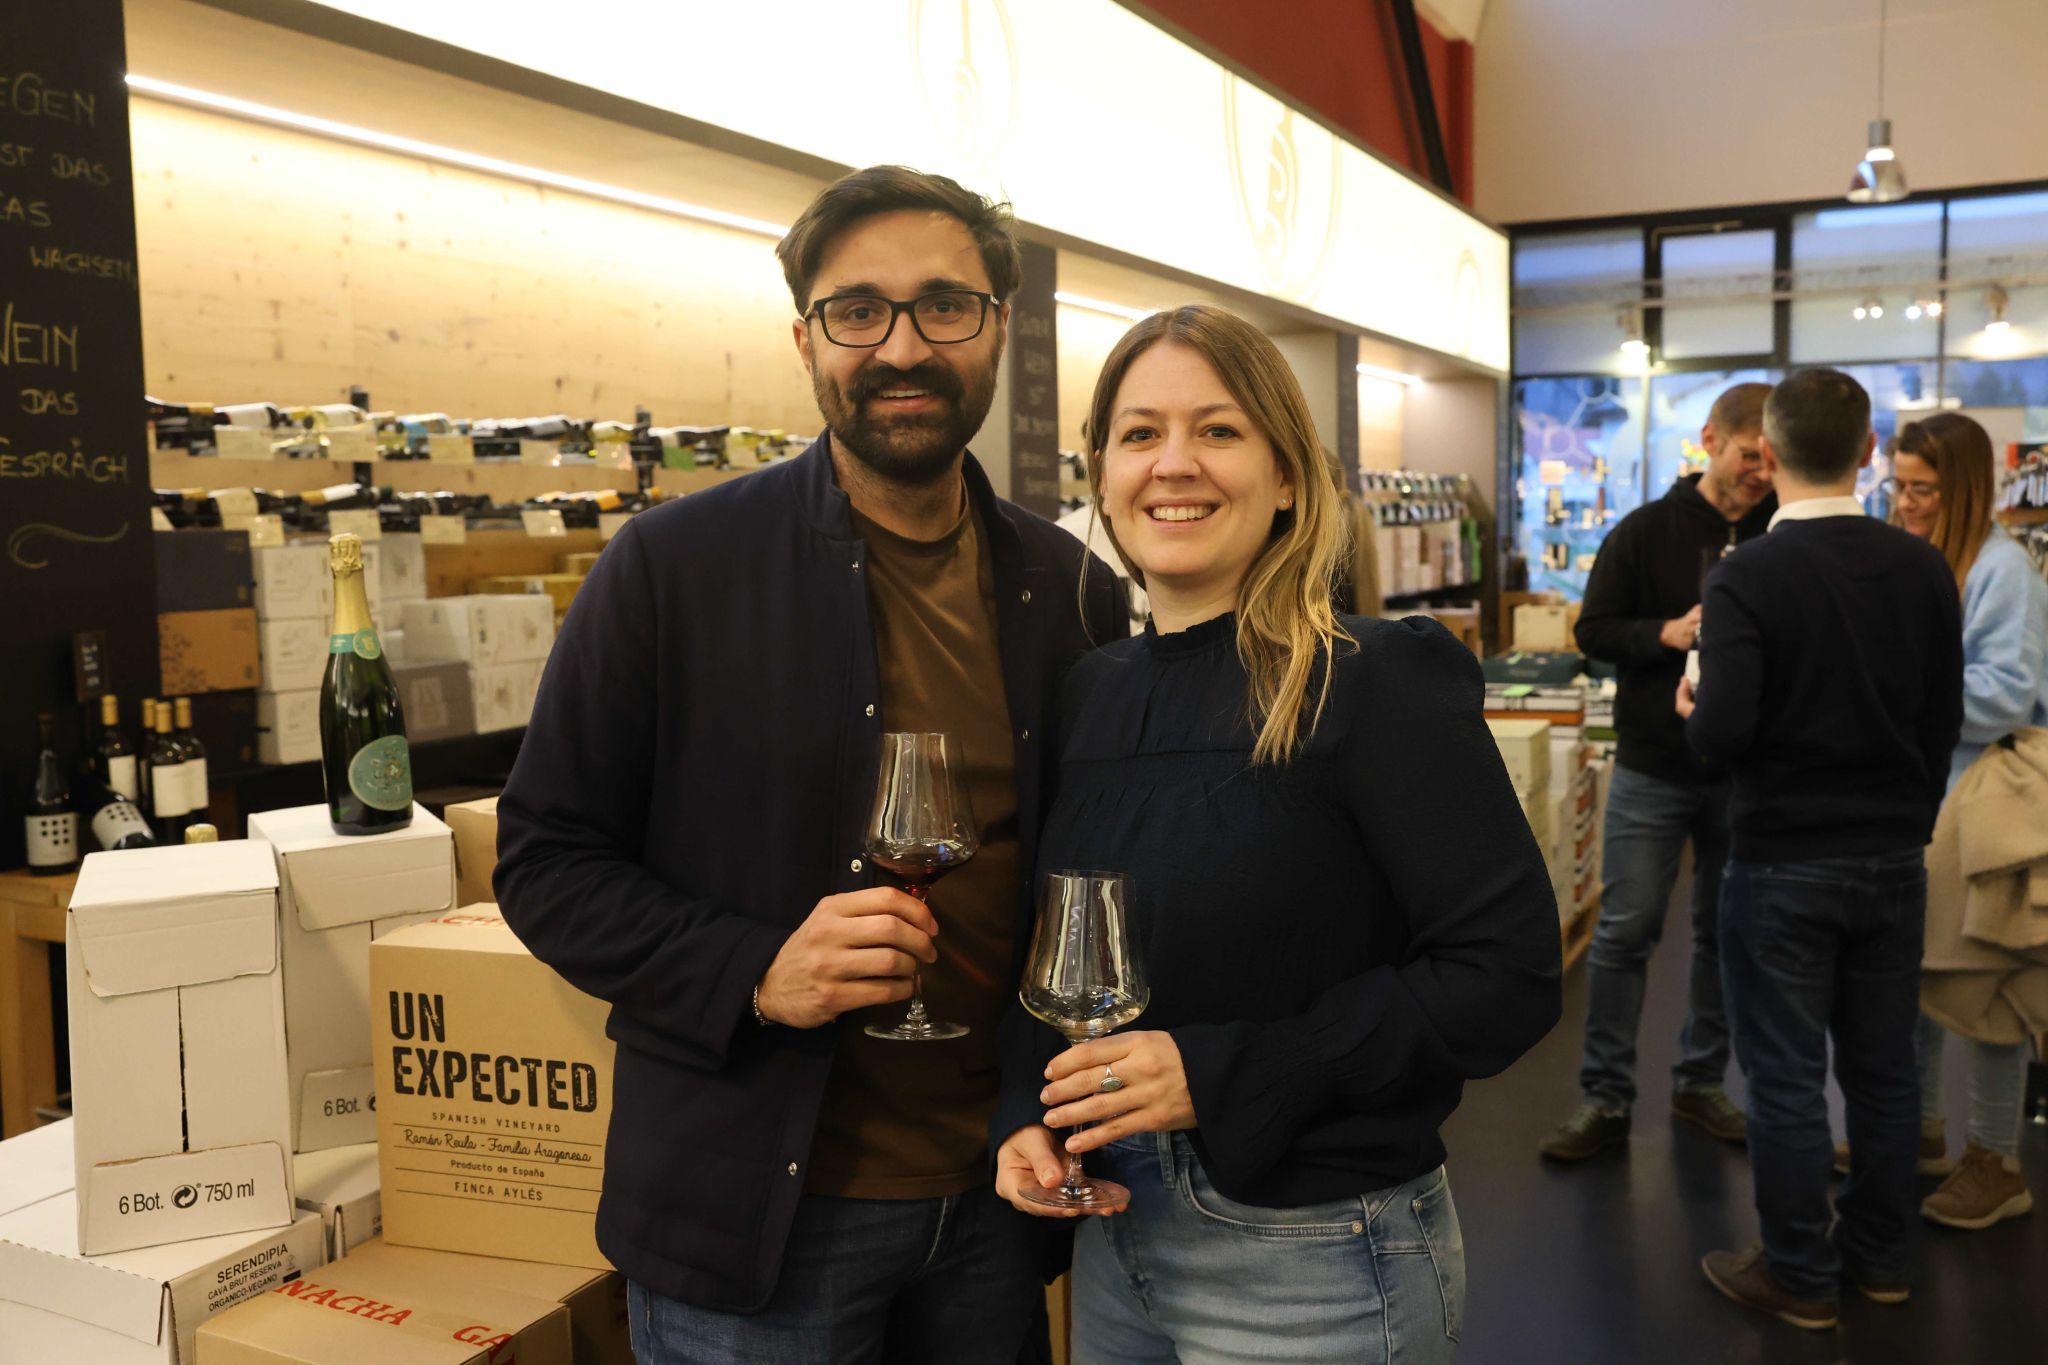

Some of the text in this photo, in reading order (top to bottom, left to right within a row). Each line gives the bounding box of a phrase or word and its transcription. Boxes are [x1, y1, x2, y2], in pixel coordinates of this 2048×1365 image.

[51, 153, 110, 187] DAS
[0, 191, 52, 228] AS
[20, 388, 80, 416] DAS
[0, 436, 129, 485] ESPRÄCH
[389, 990, 446, 1043] UN
[392, 1046, 598, 1113] EXPECTED
[323, 1097, 361, 1117] 6 Bot.
[431, 1112, 561, 1134] SPANISH VINEYARD
[403, 1129, 443, 1147] Ramón
[487, 1137, 531, 1156] Familia
[533, 1144, 592, 1164] Aragonesa
[450, 1159, 545, 1178] Producto de España
[119, 1179, 255, 1215] 6 Bot. 750 ml
[454, 1181, 543, 1201] FINCA AYLÉS
[207, 1285, 228, 1301] CAVA
[229, 1274, 249, 1291] BRUT
[249, 1260, 283, 1281] RESERVA
[217, 1243, 289, 1284] SERENDIPIA
[272, 1279, 414, 1327] NACHA
